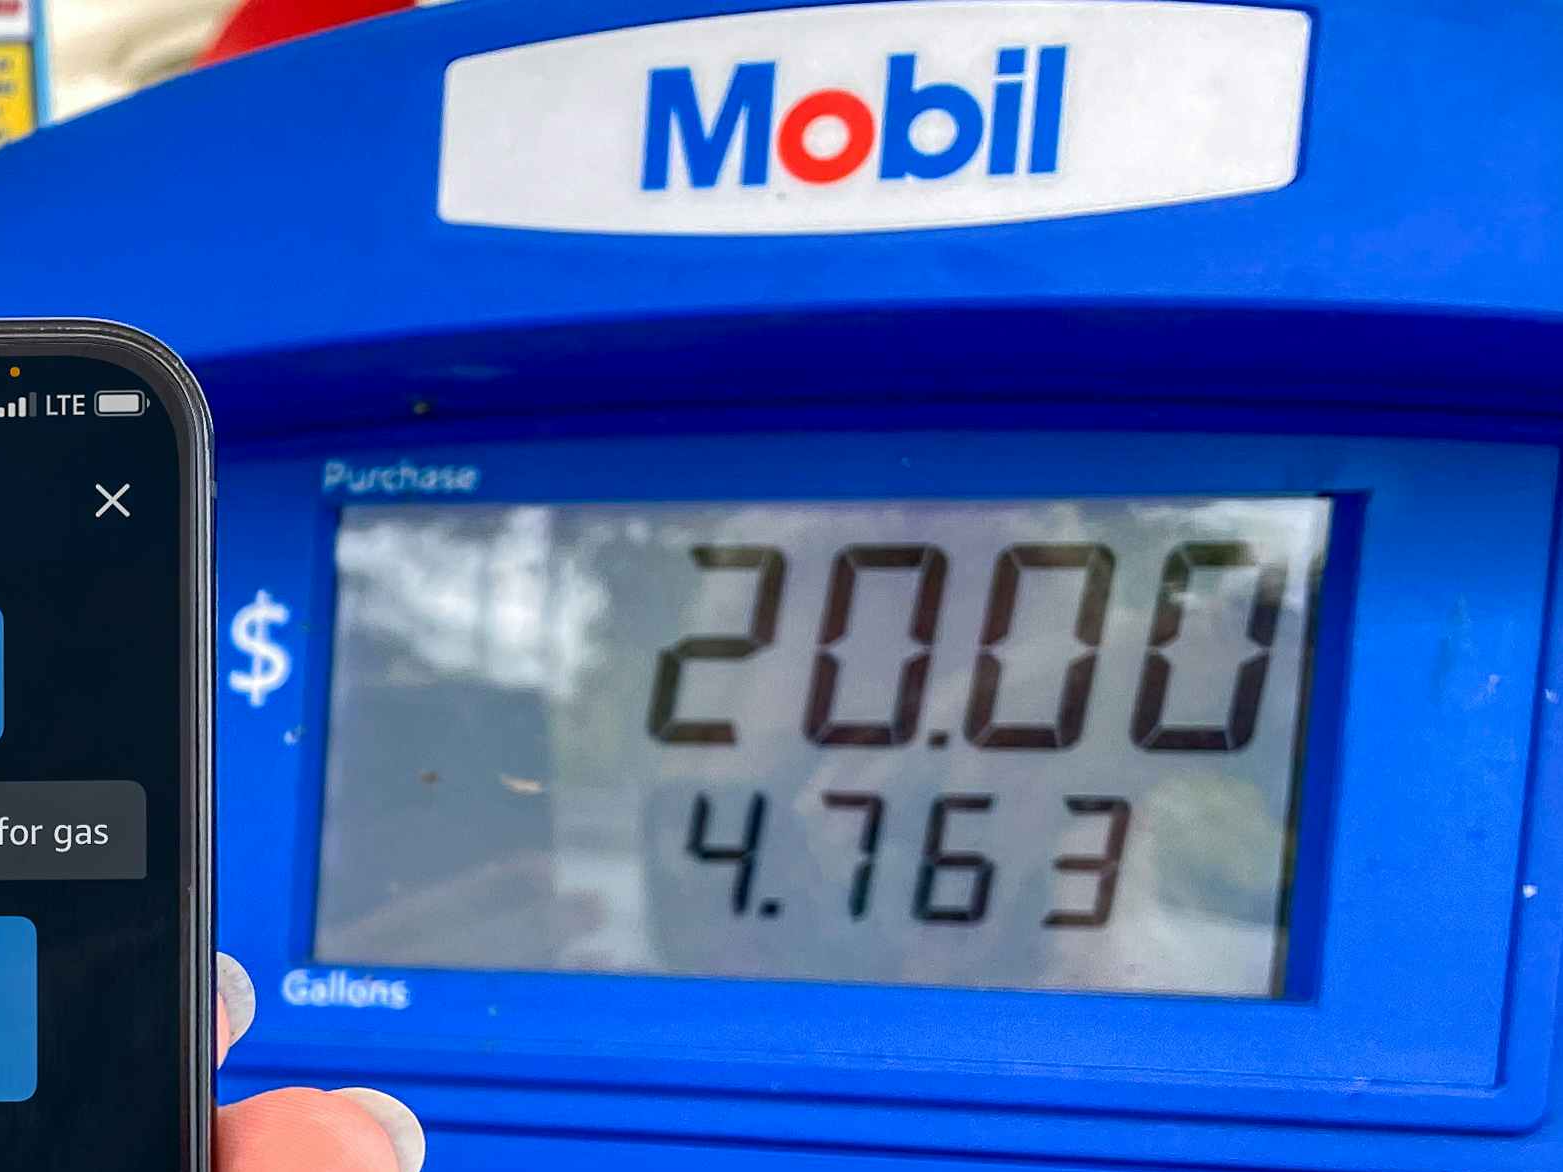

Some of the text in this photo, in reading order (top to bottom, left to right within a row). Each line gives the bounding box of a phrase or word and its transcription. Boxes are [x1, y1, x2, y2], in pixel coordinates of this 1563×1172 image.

[641, 45, 1068, 193] Mobil
[46, 394, 85, 416] LTE
[322, 460, 480, 493] Purchase
[228, 590, 292, 705] $
[648, 540, 1283, 752] 20.00
[53, 824, 109, 853] gas
[684, 792, 1133, 928] 4.763
[281, 969, 411, 1008] Gallons
